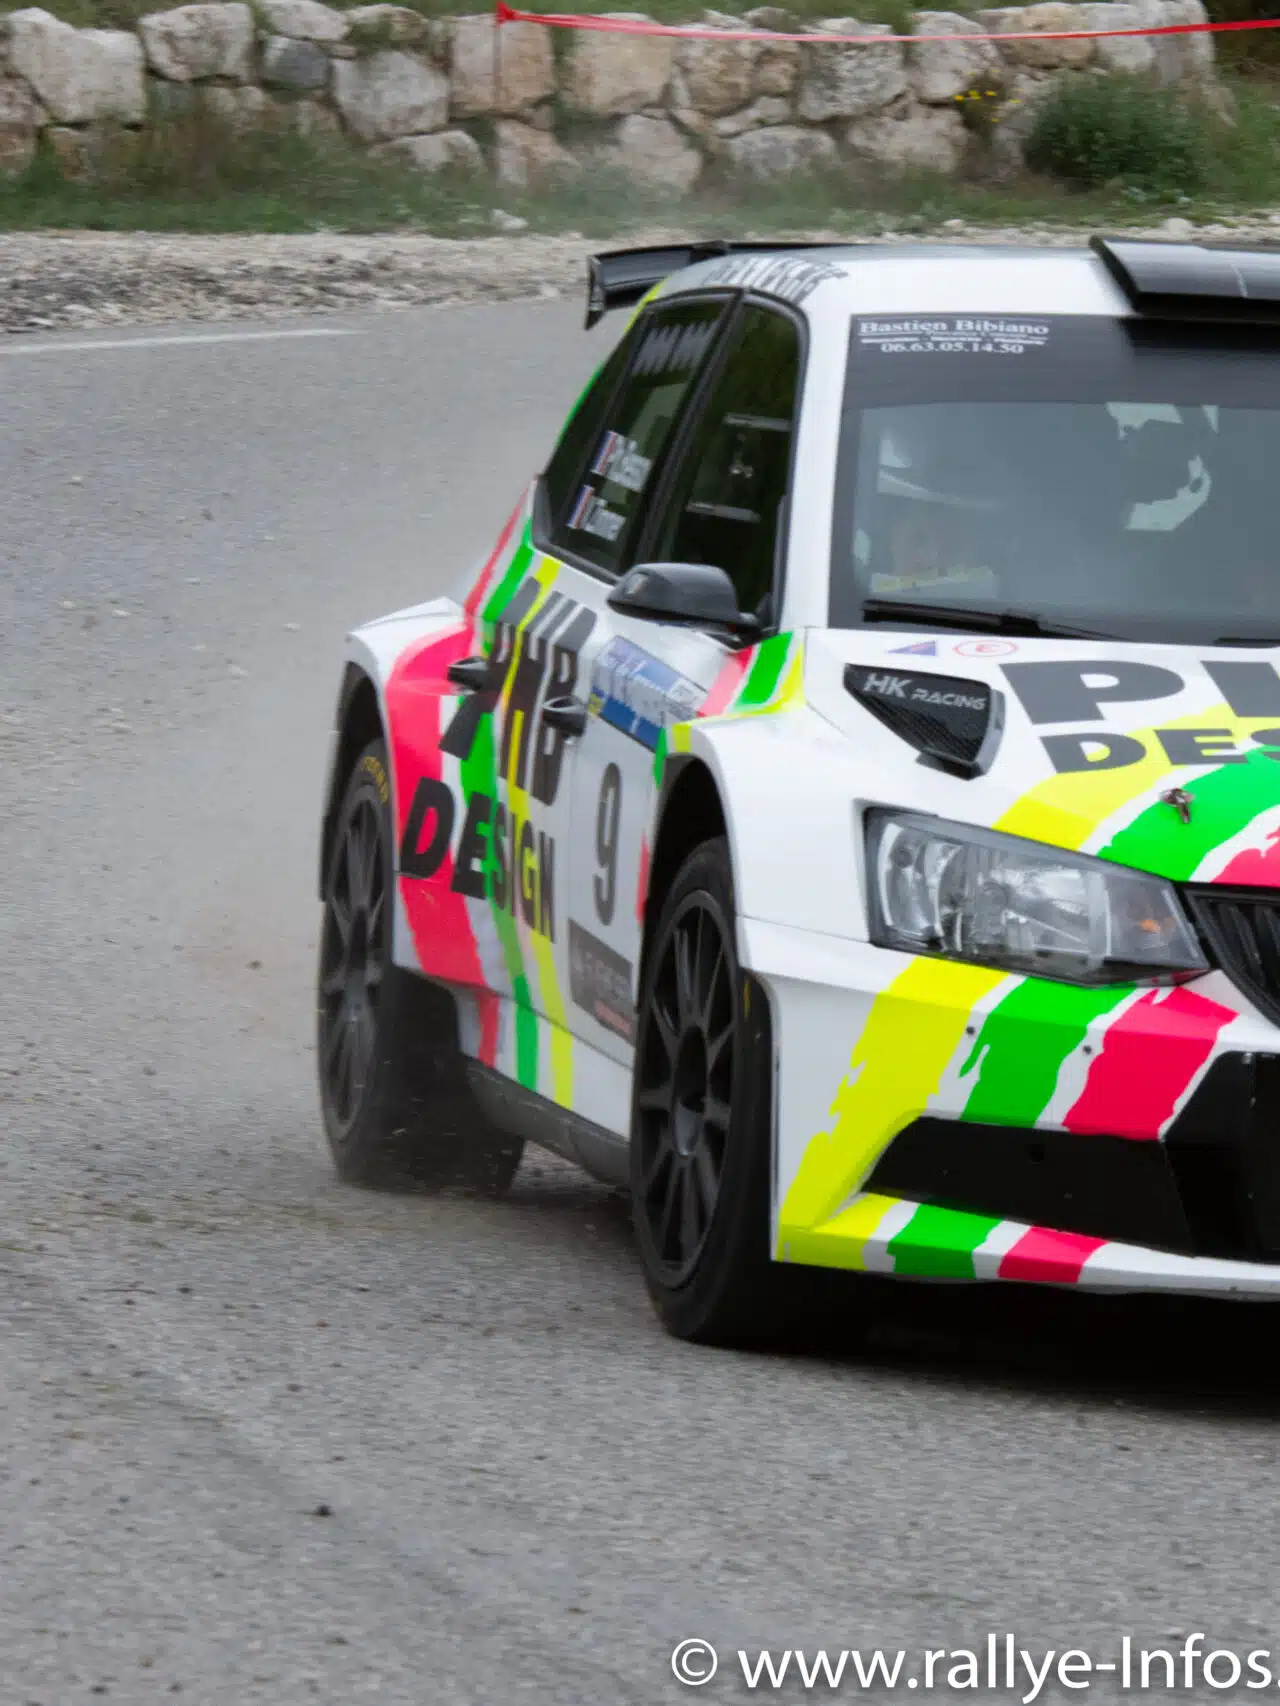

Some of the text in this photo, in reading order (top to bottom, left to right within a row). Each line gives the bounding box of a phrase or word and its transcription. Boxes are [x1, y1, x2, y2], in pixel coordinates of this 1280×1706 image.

[860, 319, 1049, 335] Bastien Bibiano
[863, 673, 987, 710] HK RACING
[399, 776, 556, 944] DESIGN
[593, 762, 621, 926] 9
